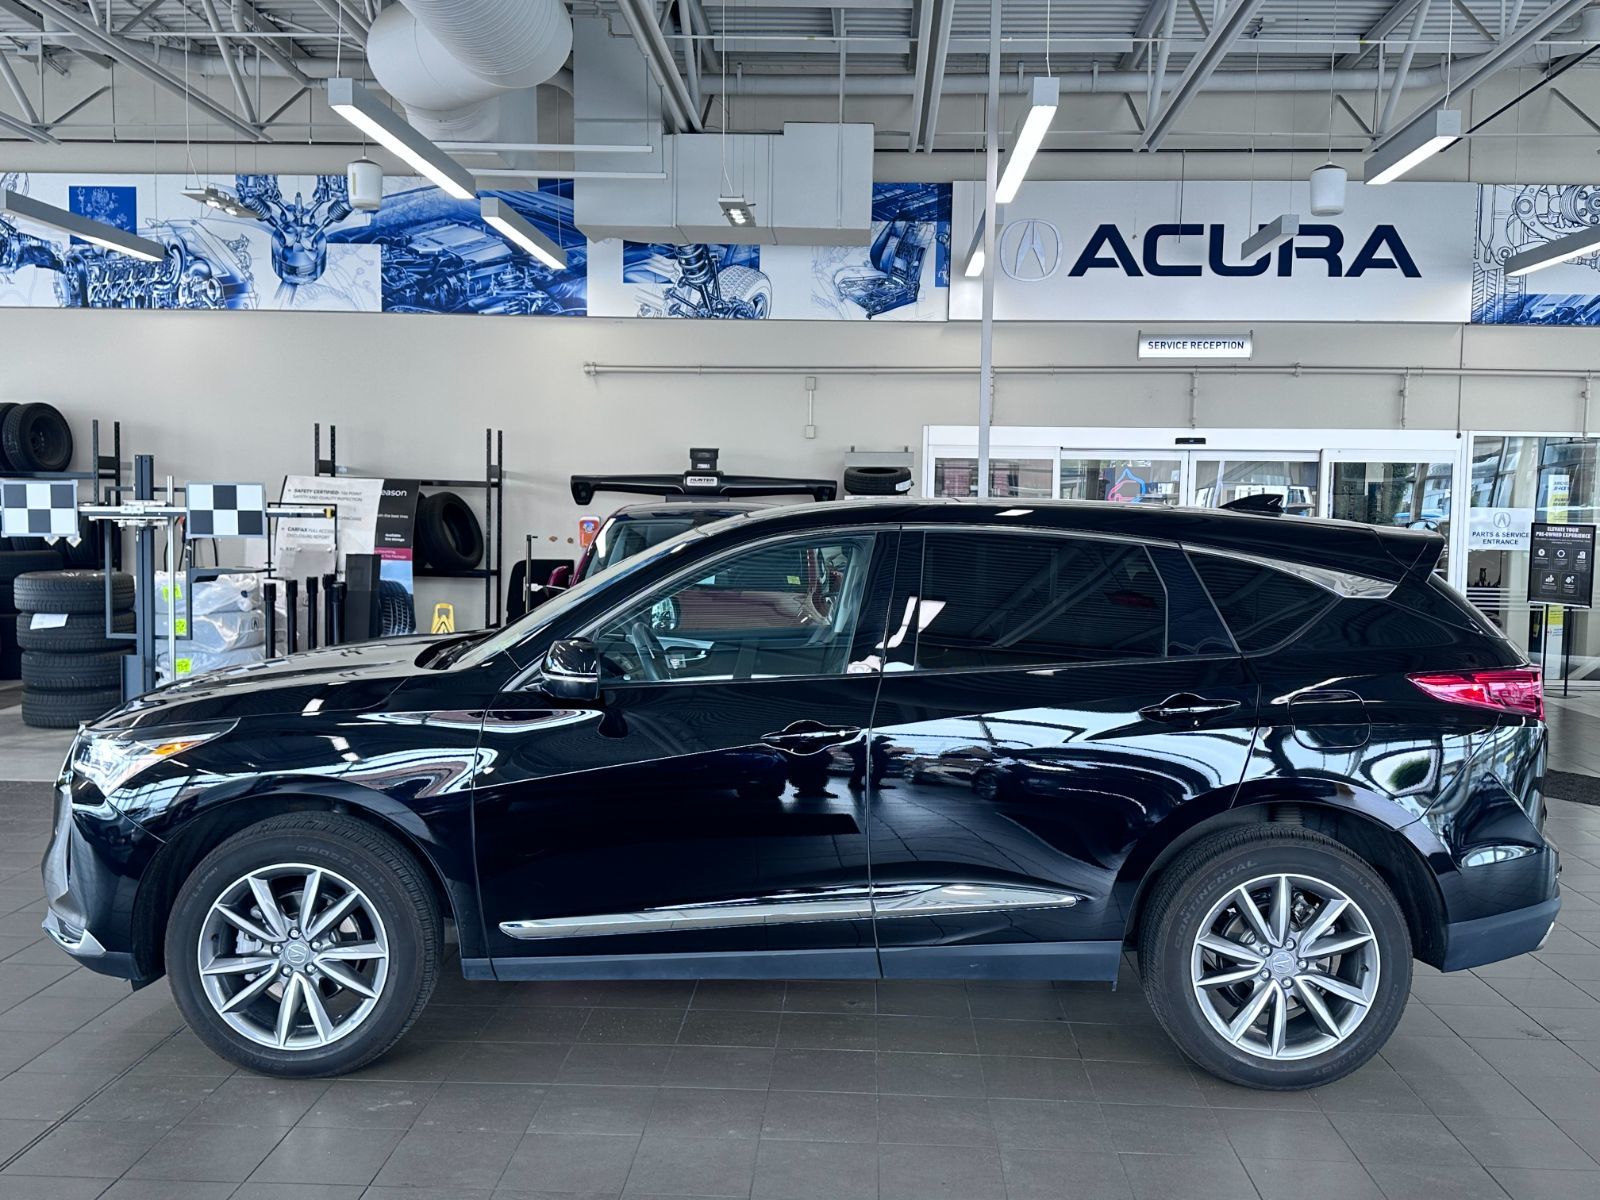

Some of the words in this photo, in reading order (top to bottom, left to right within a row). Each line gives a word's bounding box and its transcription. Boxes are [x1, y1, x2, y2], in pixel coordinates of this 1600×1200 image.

[1067, 223, 1422, 278] ACURA
[1148, 341, 1188, 350] SERVICE
[1190, 341, 1244, 350] RECEPTION
[1174, 859, 1258, 949] CONTINENTAL
